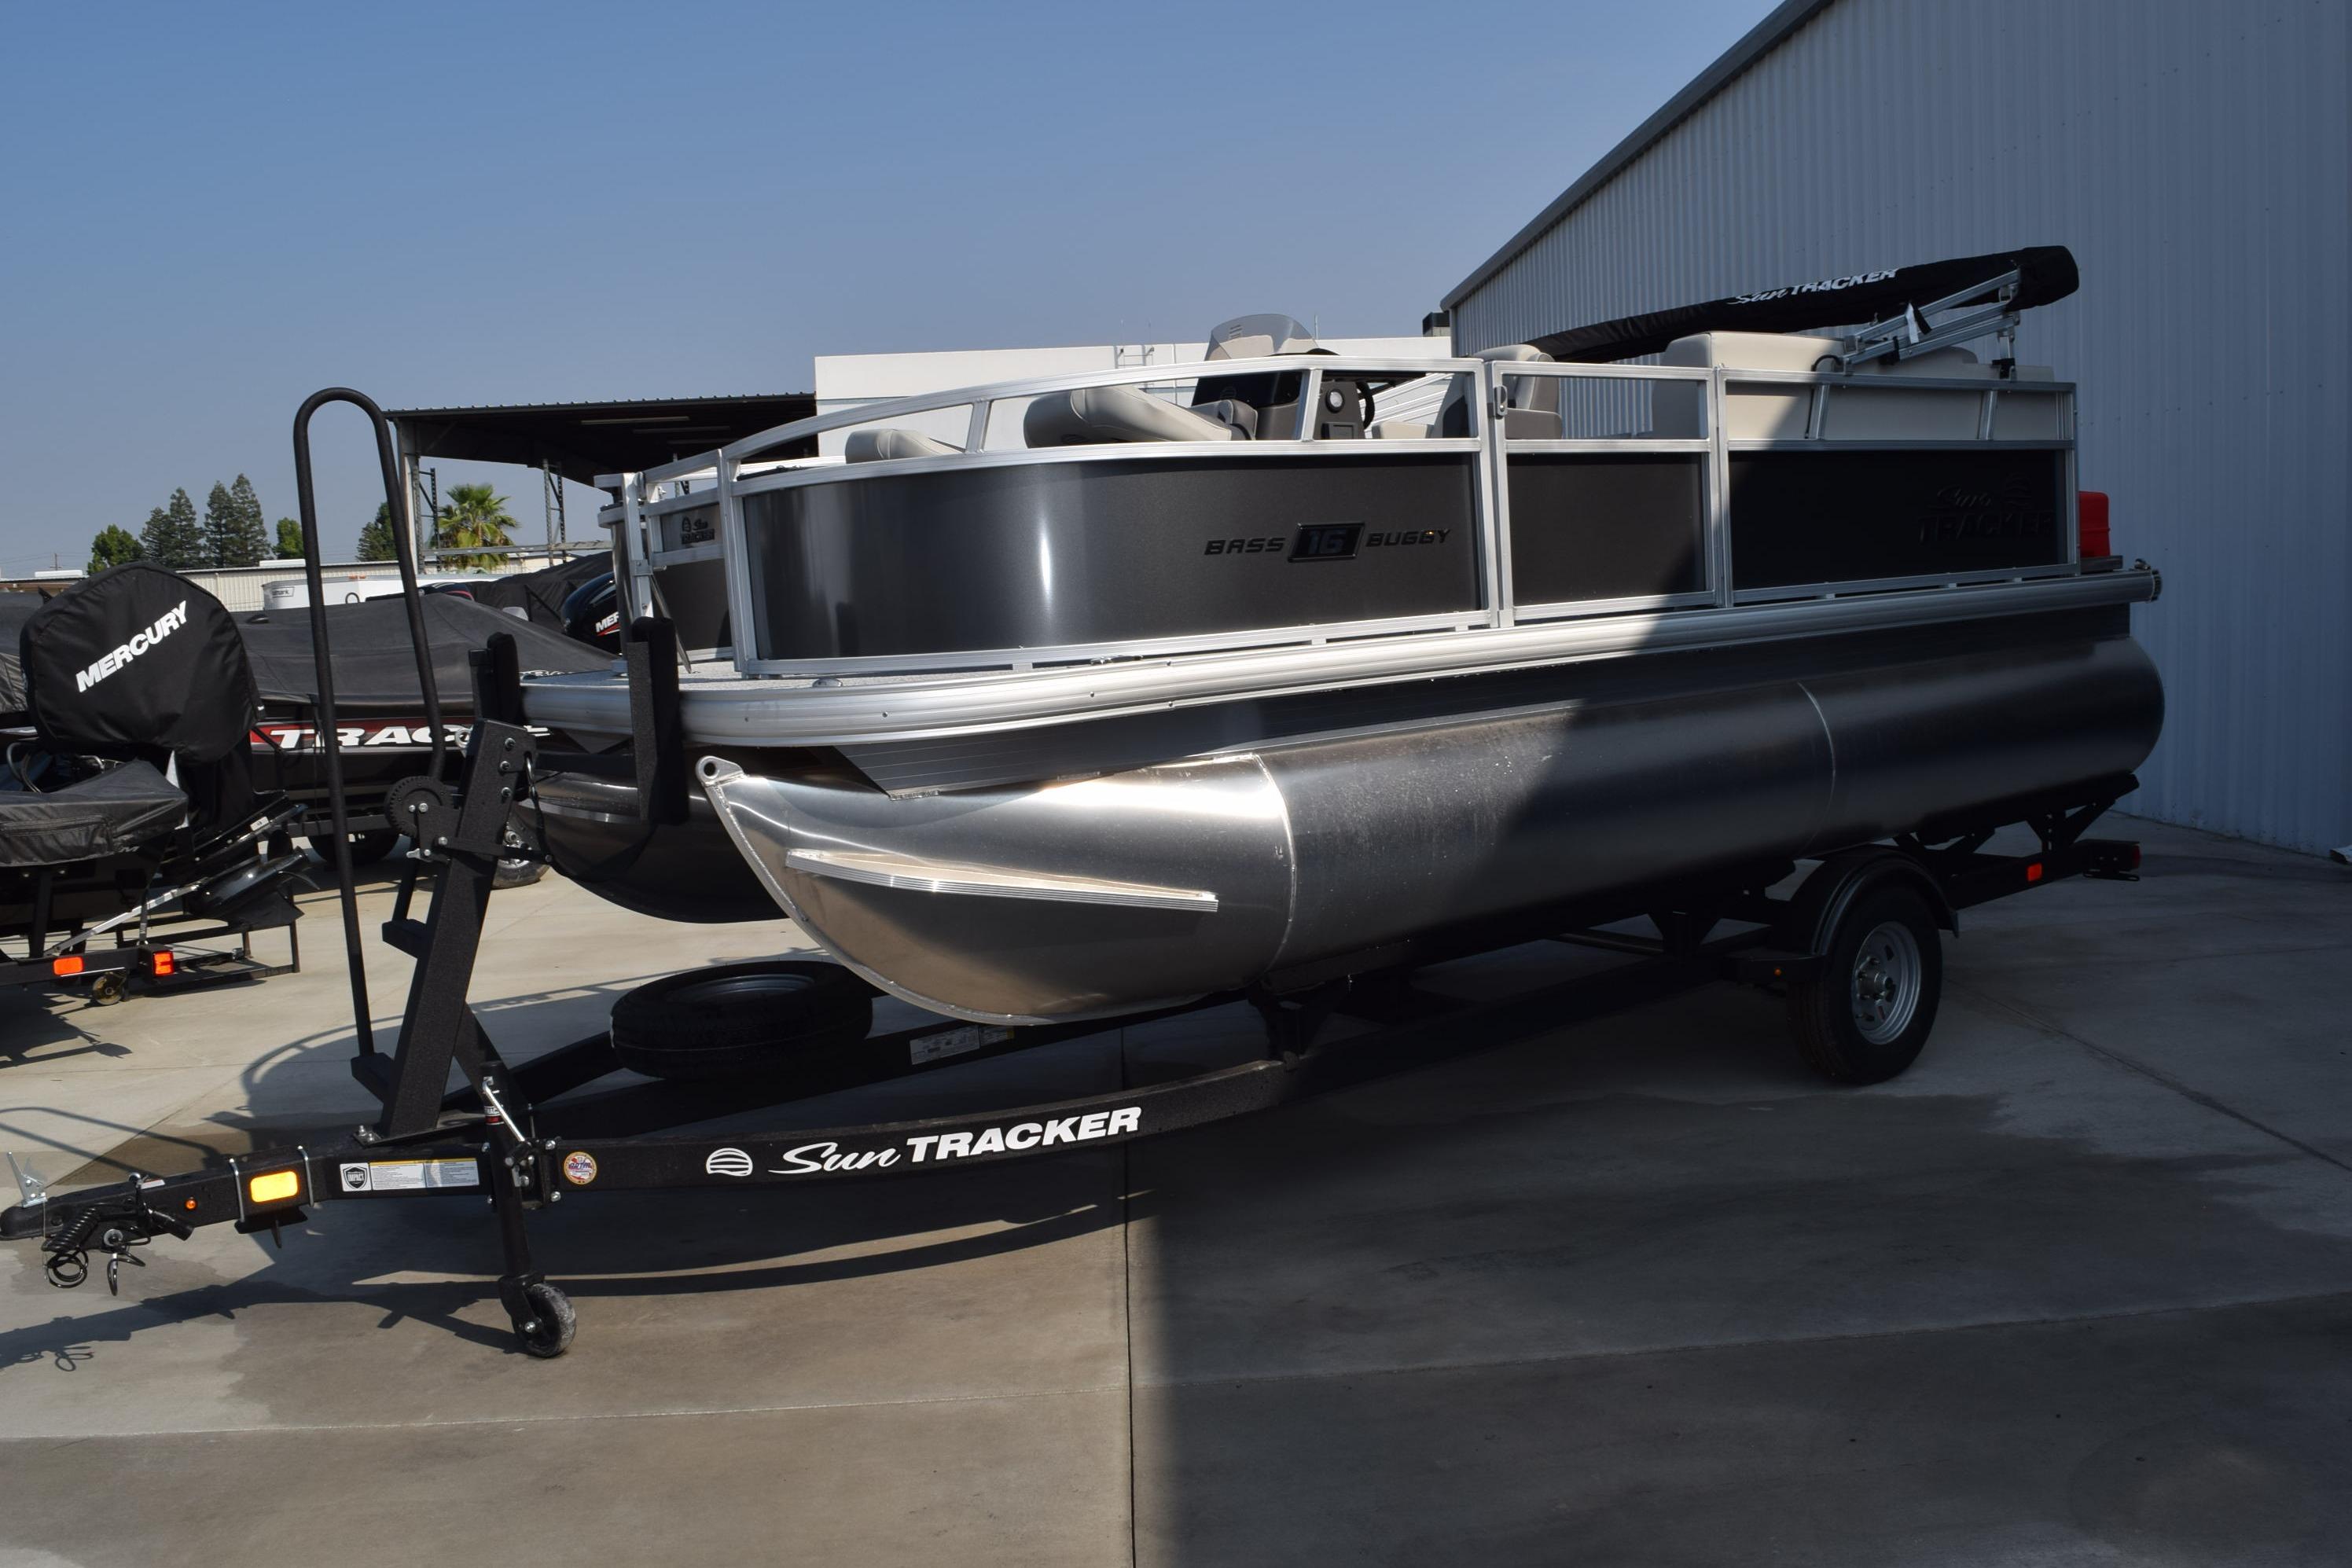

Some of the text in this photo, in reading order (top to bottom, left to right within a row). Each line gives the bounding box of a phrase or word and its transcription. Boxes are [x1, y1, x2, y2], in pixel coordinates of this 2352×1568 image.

[1726, 267, 1900, 305] Sun TRACKER
[1204, 527, 1451, 556] BASS 16 BUGGY
[75, 600, 187, 692] MERCURY
[767, 1107, 1142, 1174] Sun TRACKER
